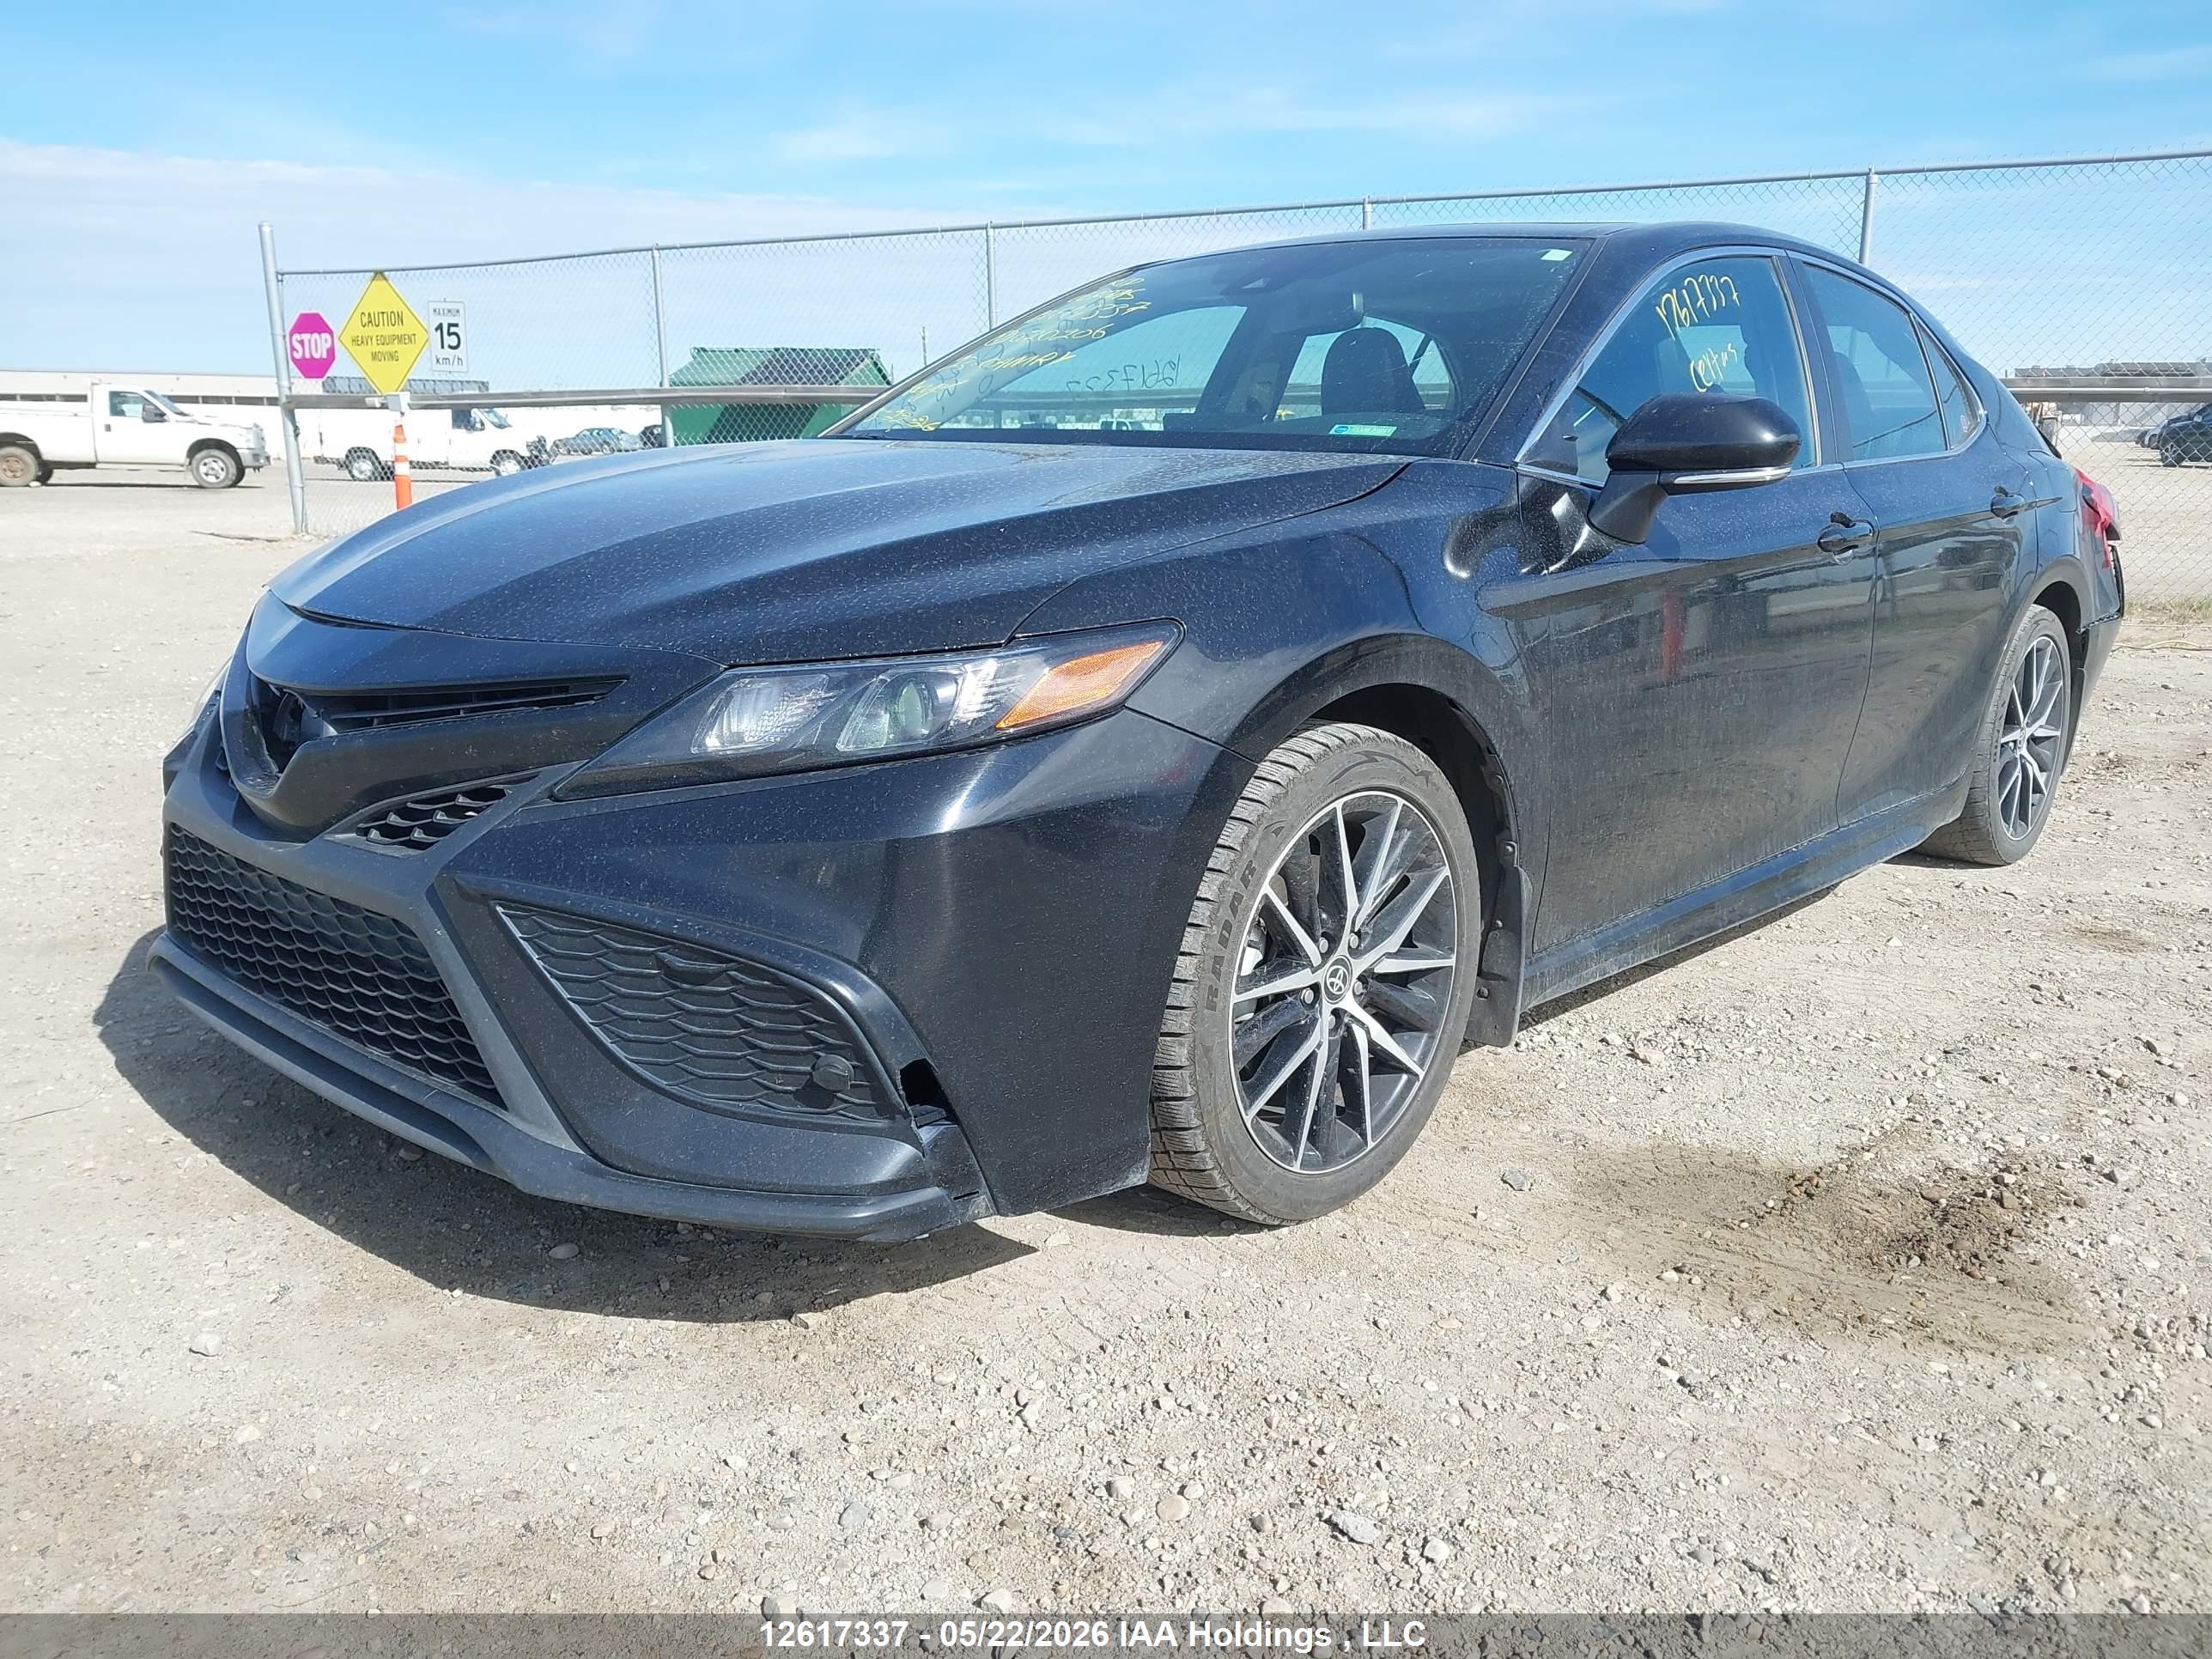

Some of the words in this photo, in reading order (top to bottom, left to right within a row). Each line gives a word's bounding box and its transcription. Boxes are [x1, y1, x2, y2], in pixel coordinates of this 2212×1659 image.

[360, 311, 404, 328] CAUTION
[433, 307, 461, 317] MAXIMUM
[351, 334, 374, 346] HEAVY
[376, 333, 416, 345] EQUIPMENT
[434, 322, 461, 350] 15
[292, 332, 331, 359] STOP
[371, 349, 399, 362] MOVING
[435, 354, 464, 367] km/h
[1206, 860, 1257, 1012] RADAR
